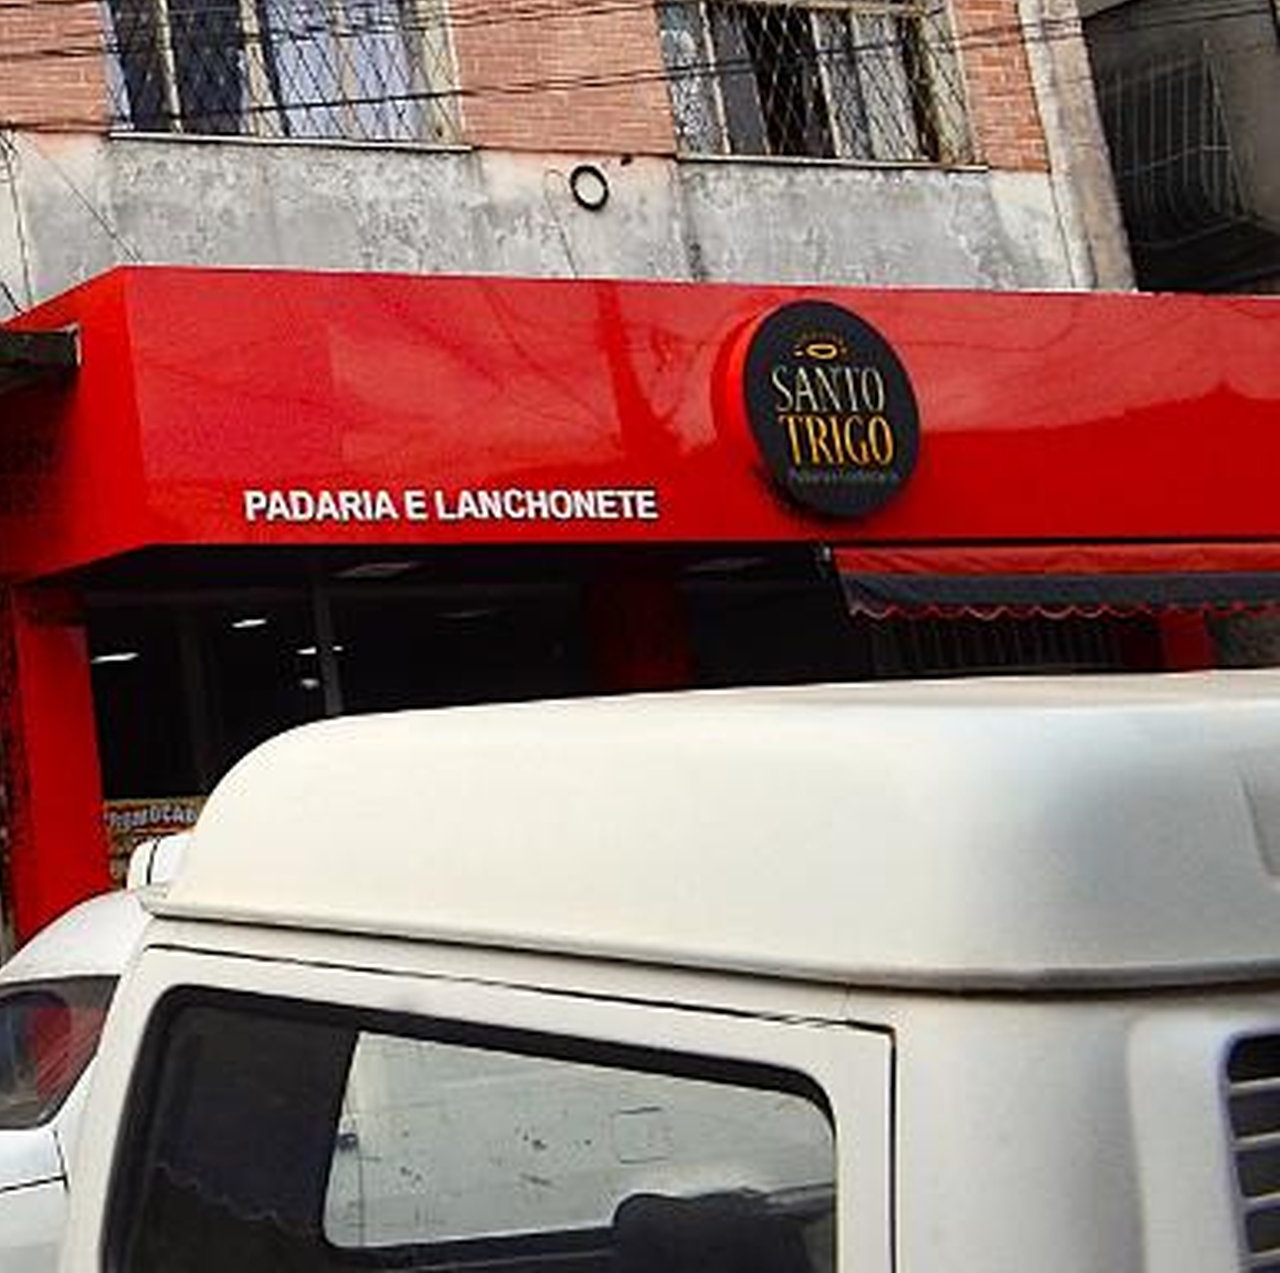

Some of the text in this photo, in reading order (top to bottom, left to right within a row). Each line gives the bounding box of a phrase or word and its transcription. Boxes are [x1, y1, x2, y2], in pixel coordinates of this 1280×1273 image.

[771, 365, 885, 413] SANTO
[777, 414, 895, 465] TRIGO
[243, 489, 660, 521] PADARIA E LANCHONETE
